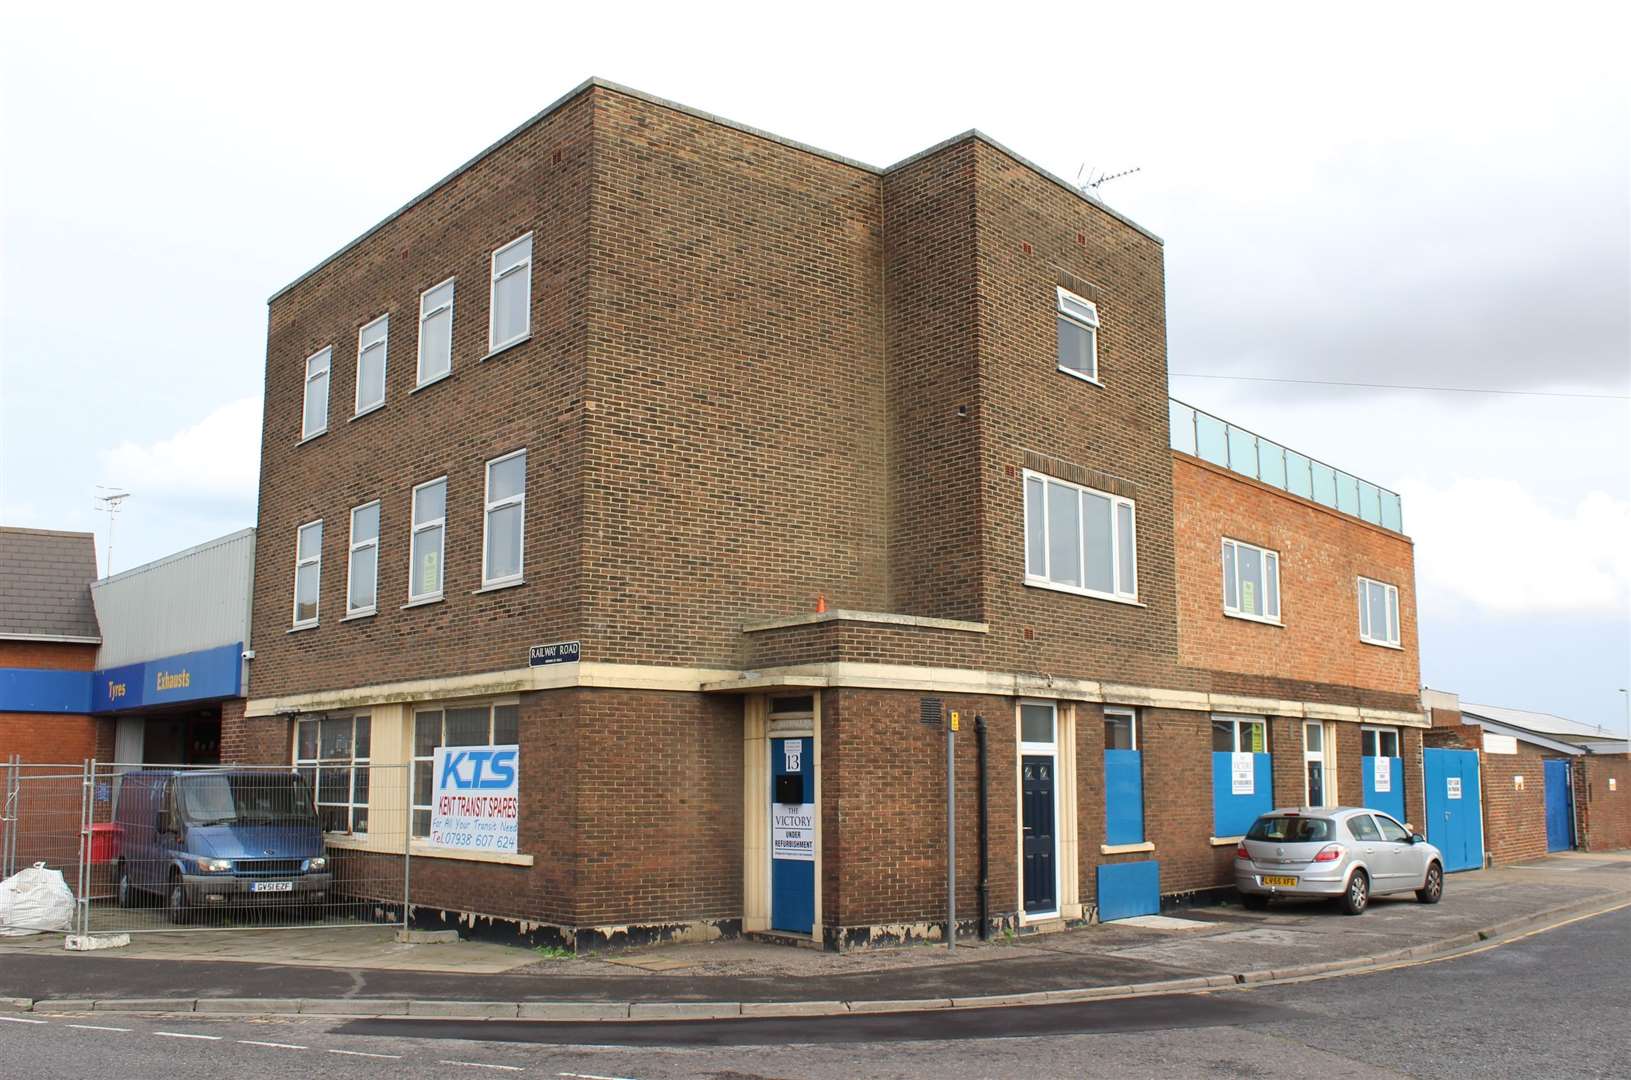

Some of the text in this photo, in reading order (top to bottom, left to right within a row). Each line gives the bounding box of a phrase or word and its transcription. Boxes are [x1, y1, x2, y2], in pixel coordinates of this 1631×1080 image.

[531, 644, 578, 658] RAILWAY ROAD
[157, 670, 190, 691] Exhausts
[108, 681, 126, 702] Tyres
[787, 754, 799, 770] 13
[440, 751, 517, 789] KTS
[439, 796, 517, 818] KENT TRANSIT SPARES
[788, 807, 799, 815] THE
[433, 818, 442, 829] For
[456, 819, 471, 830] Your
[473, 819, 497, 832] Transit
[775, 815, 812, 827] VICTORY
[444, 832, 473, 846] 07938
[475, 835, 494, 847] 607
[496, 836, 515, 849] 624
[785, 831, 801, 839] UNDER
[775, 839, 813, 849] REFURBISHMENT
